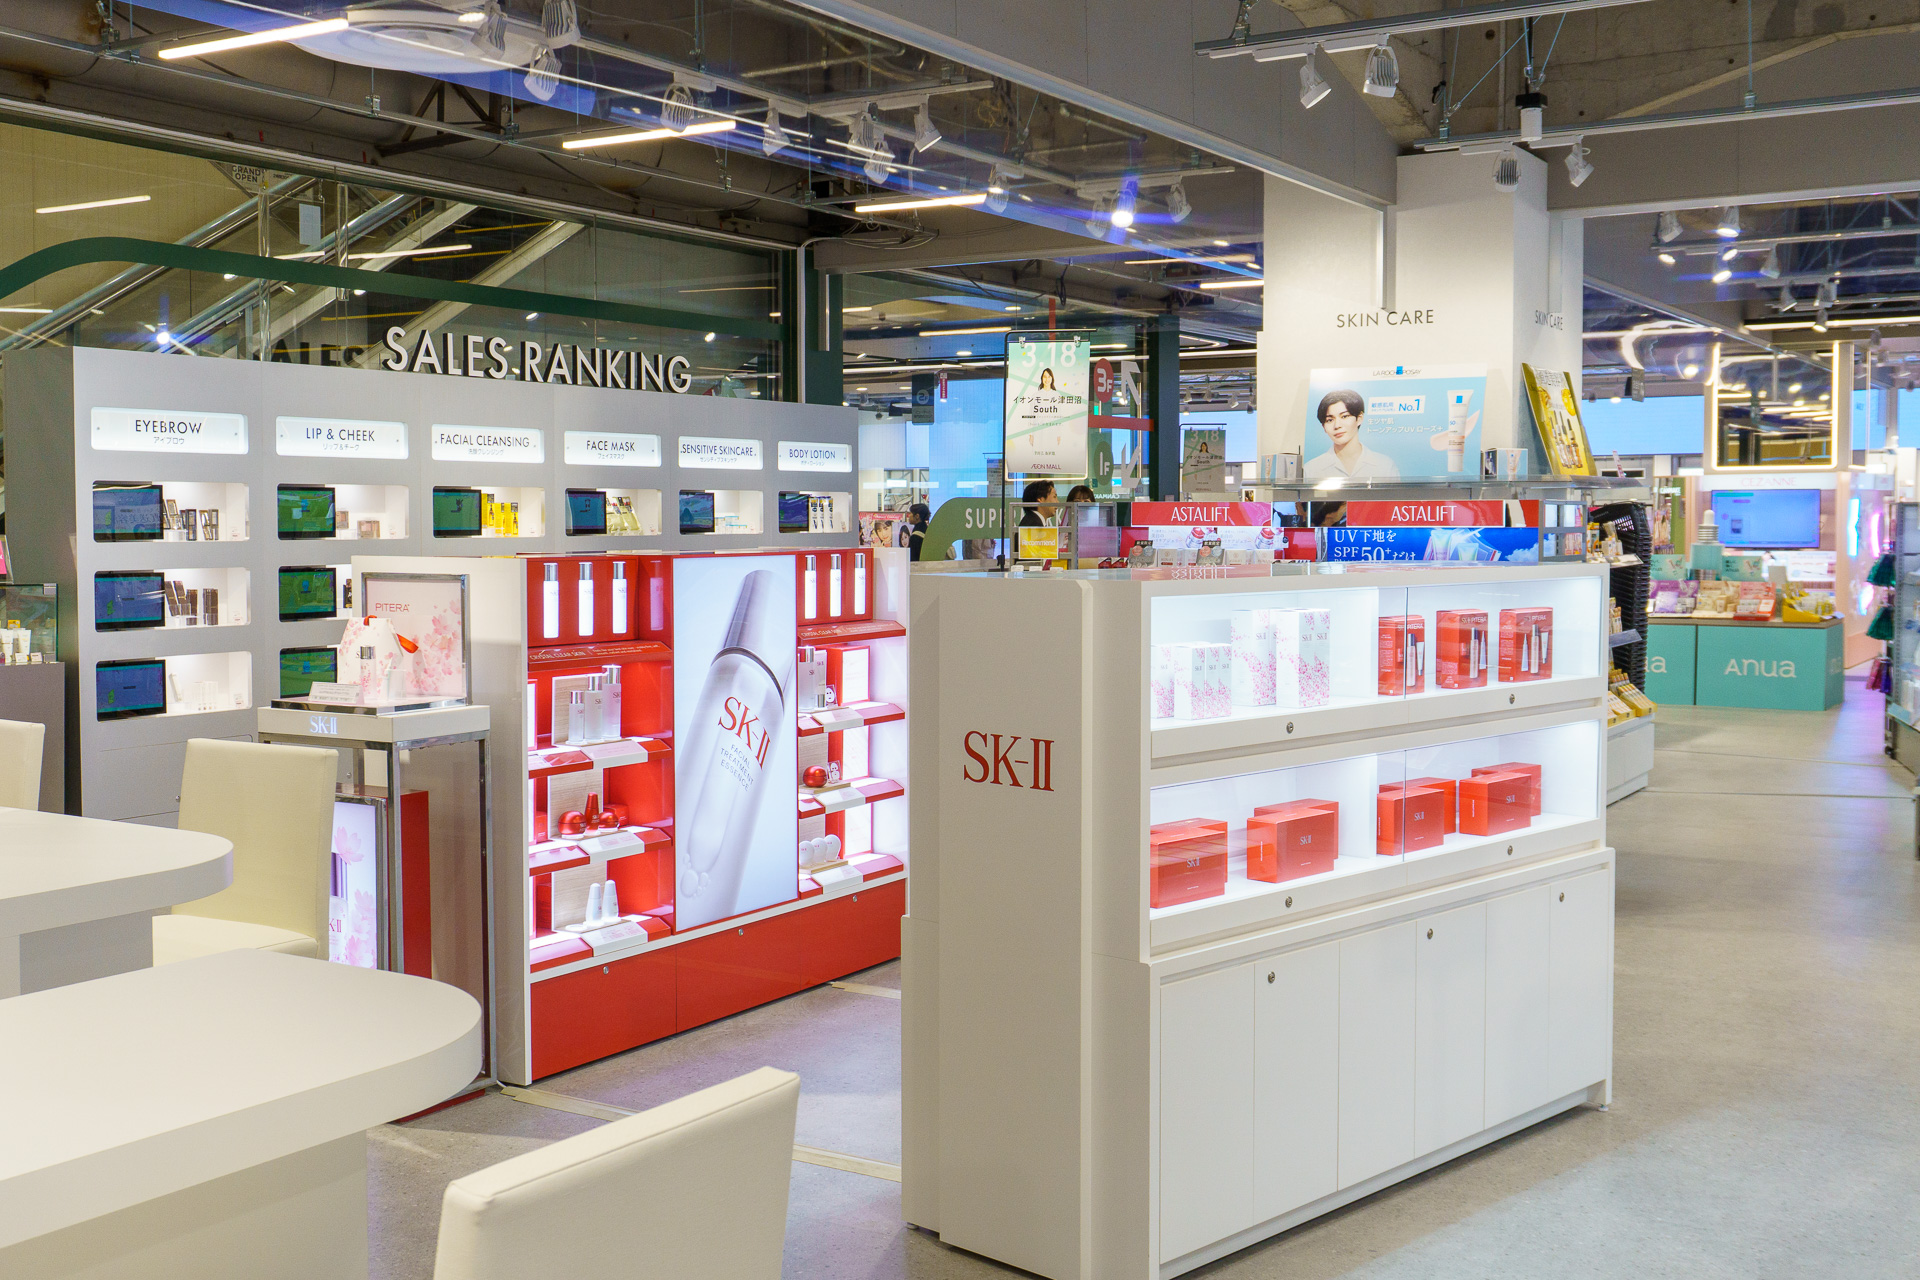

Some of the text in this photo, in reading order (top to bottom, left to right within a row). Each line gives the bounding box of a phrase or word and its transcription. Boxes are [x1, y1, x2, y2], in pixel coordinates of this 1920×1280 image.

[232, 165, 260, 176] GRAND
[234, 173, 258, 183] OPEN
[1336, 309, 1434, 328] SKIN CARE
[1535, 309, 1563, 330] SKIN CARE
[383, 326, 692, 394] SALES RANKING
[1022, 342, 1076, 368] 3.18
[1097, 368, 1112, 393] 3F
[1014, 395, 1082, 405] イオンモール津田沼
[1398, 398, 1421, 412] No.1
[1033, 405, 1058, 413] South
[135, 419, 202, 434] EYEBROW
[306, 427, 375, 441] LIP & CHEEK
[154, 436, 185, 444] アイブロウ
[440, 433, 530, 448] FACIAL CLEANSING
[586, 440, 635, 451] FACE MASK
[682, 444, 753, 456] SENSITIVE SKINCARE
[789, 448, 836, 459] BODY LOTION
[1741, 477, 1798, 487] CEZANNE
[1171, 506, 1230, 522] ASTALIFT
[1390, 505, 1457, 522] ASTALIFT
[375, 603, 410, 612] PITERA
[1724, 658, 1797, 678] Anua
[309, 715, 338, 735] SK-II
[718, 696, 771, 770] SK-II
[731, 744, 750, 769] FACIAL
[963, 730, 1055, 792] SK-II
[720, 748, 754, 785] TREATMENT
[720, 759, 750, 792] ESSENCE
